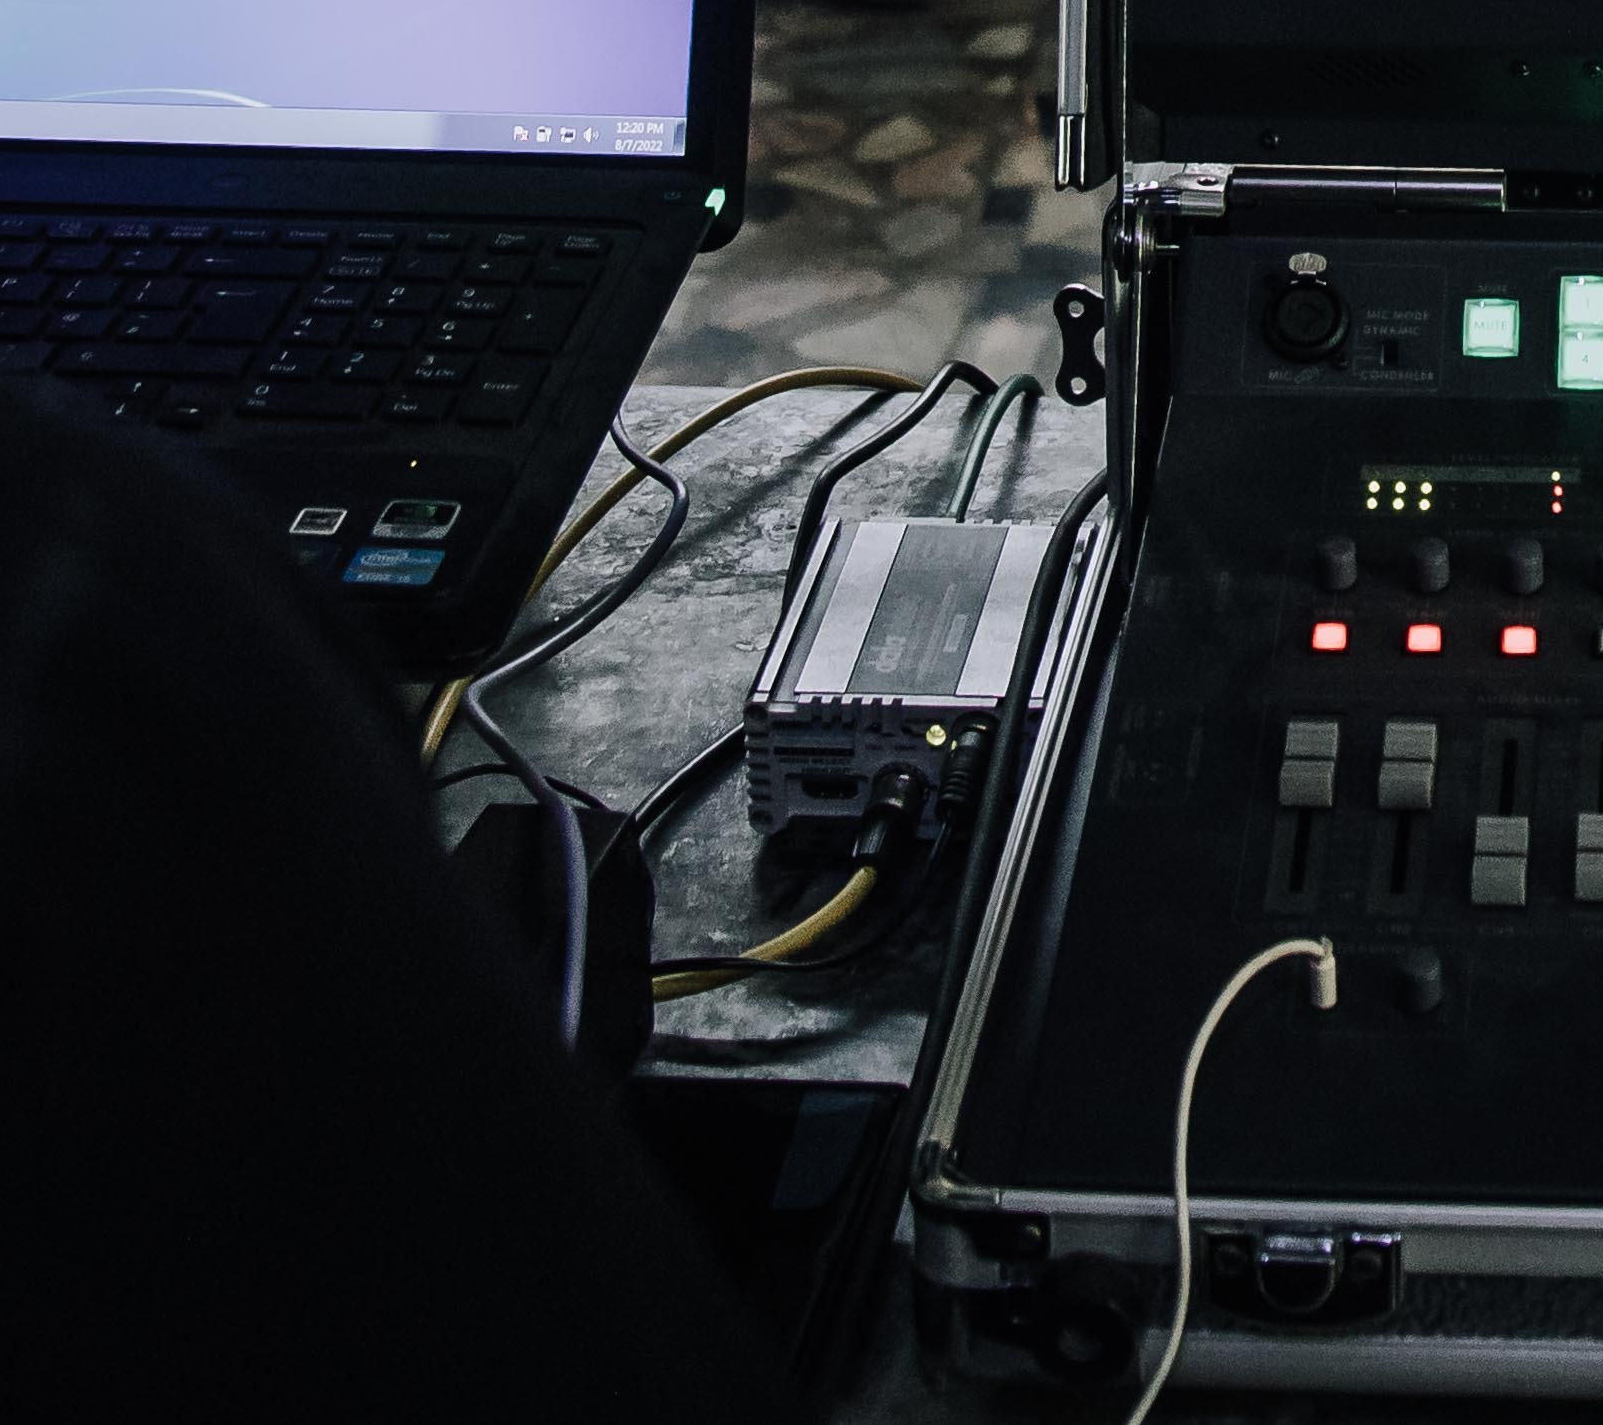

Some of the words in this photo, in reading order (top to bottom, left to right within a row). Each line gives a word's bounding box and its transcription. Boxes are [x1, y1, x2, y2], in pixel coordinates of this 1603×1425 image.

[616, 122, 644, 135] 12:20
[647, 123, 664, 135] PM
[614, 140, 663, 153] 8/7/2022
